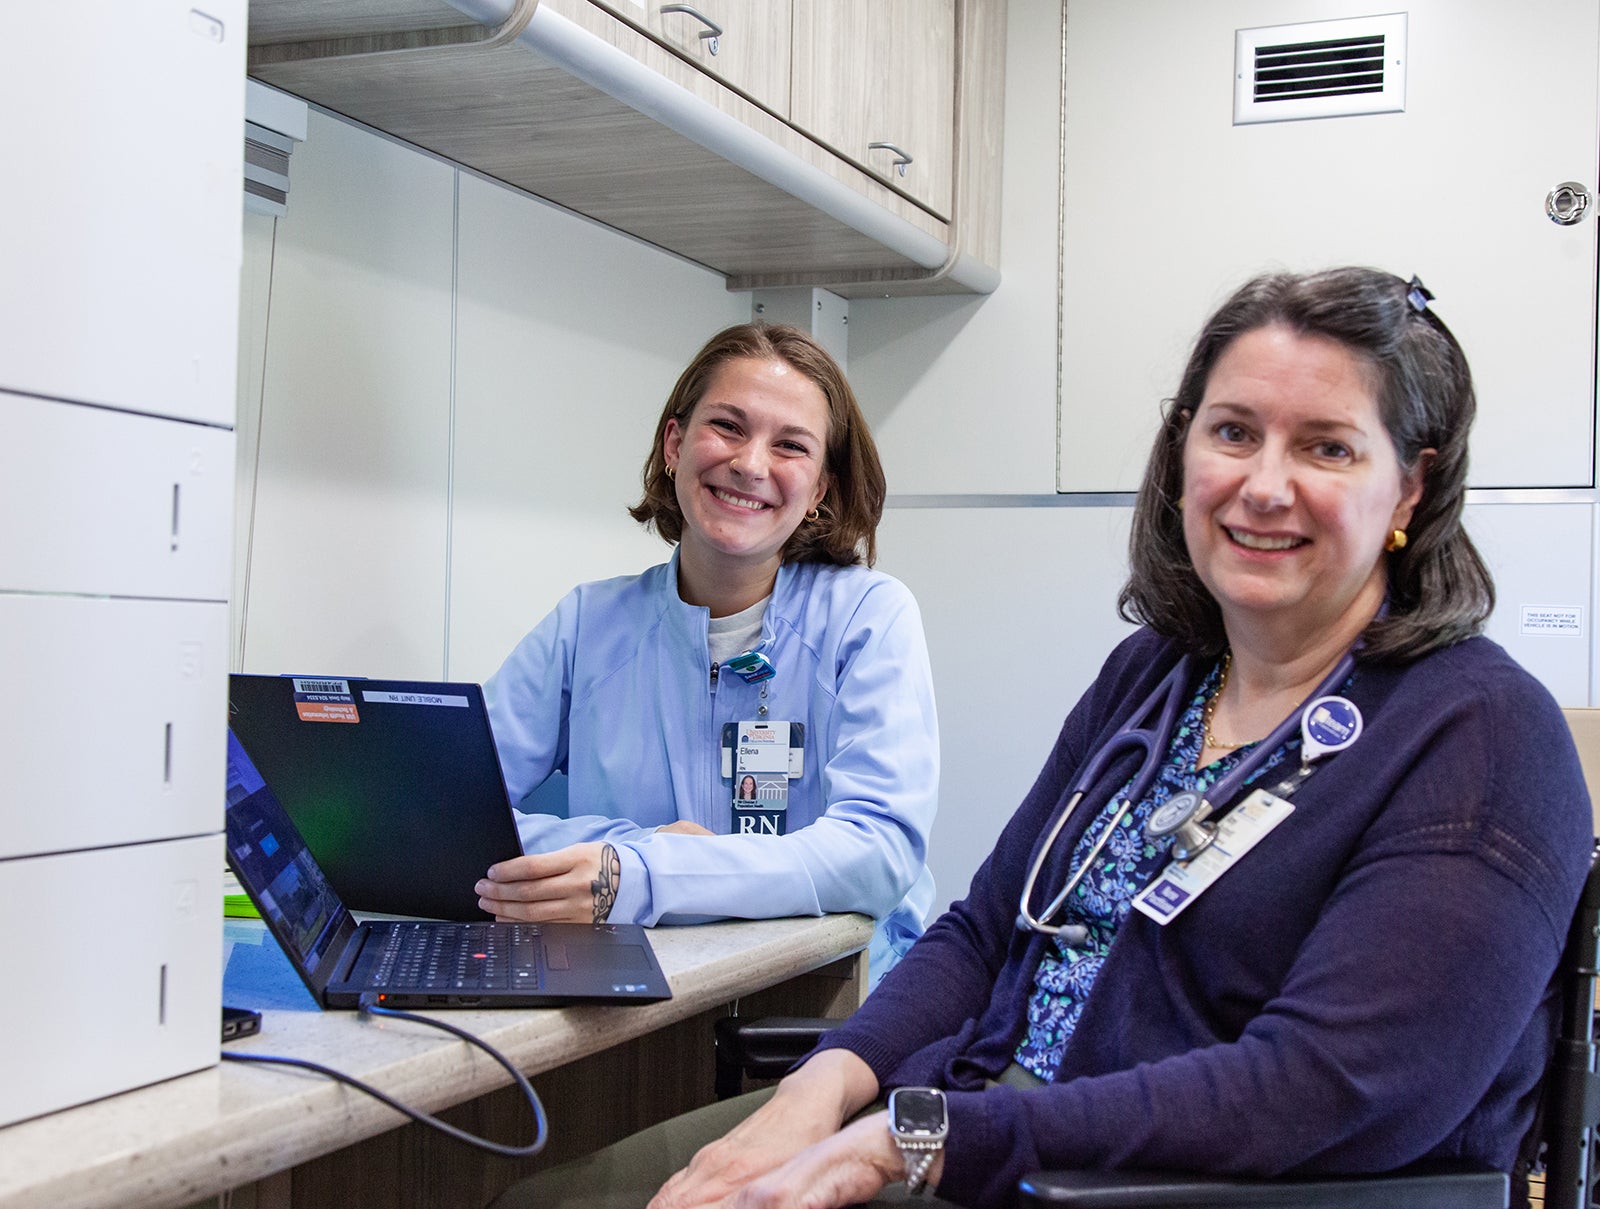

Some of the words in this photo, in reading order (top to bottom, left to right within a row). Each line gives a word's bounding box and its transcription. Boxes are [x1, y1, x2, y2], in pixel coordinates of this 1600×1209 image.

[388, 694, 399, 702] RN
[401, 694, 415, 702] UNIT
[418, 695, 443, 704] MOBILE
[740, 747, 759, 755] Ellena
[738, 815, 780, 836] RN
